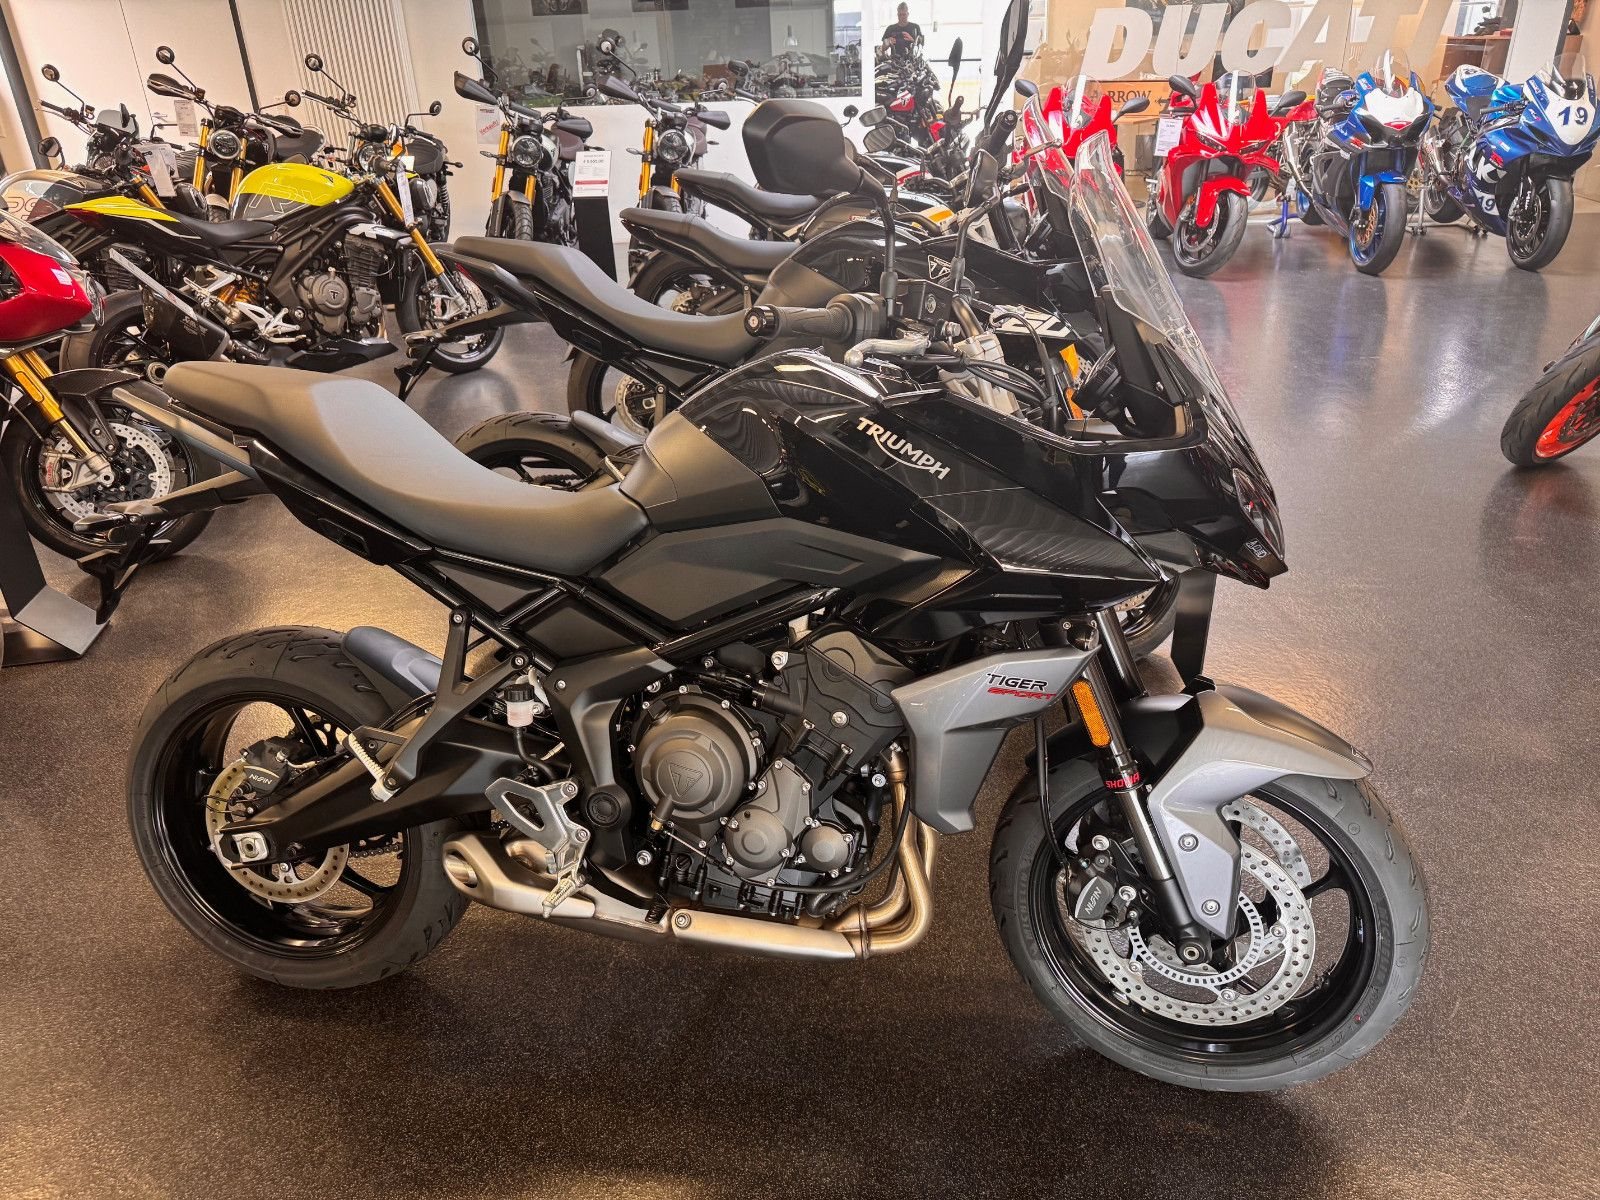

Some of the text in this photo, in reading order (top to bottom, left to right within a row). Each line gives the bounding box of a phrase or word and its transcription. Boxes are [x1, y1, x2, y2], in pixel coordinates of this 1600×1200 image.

[1081, 0, 1452, 80] DUCATI
[1558, 105, 1589, 126] 19
[856, 416, 951, 480] TRIUMPH
[986, 673, 1049, 691] TIGER
[987, 687, 1057, 700] SPORT
